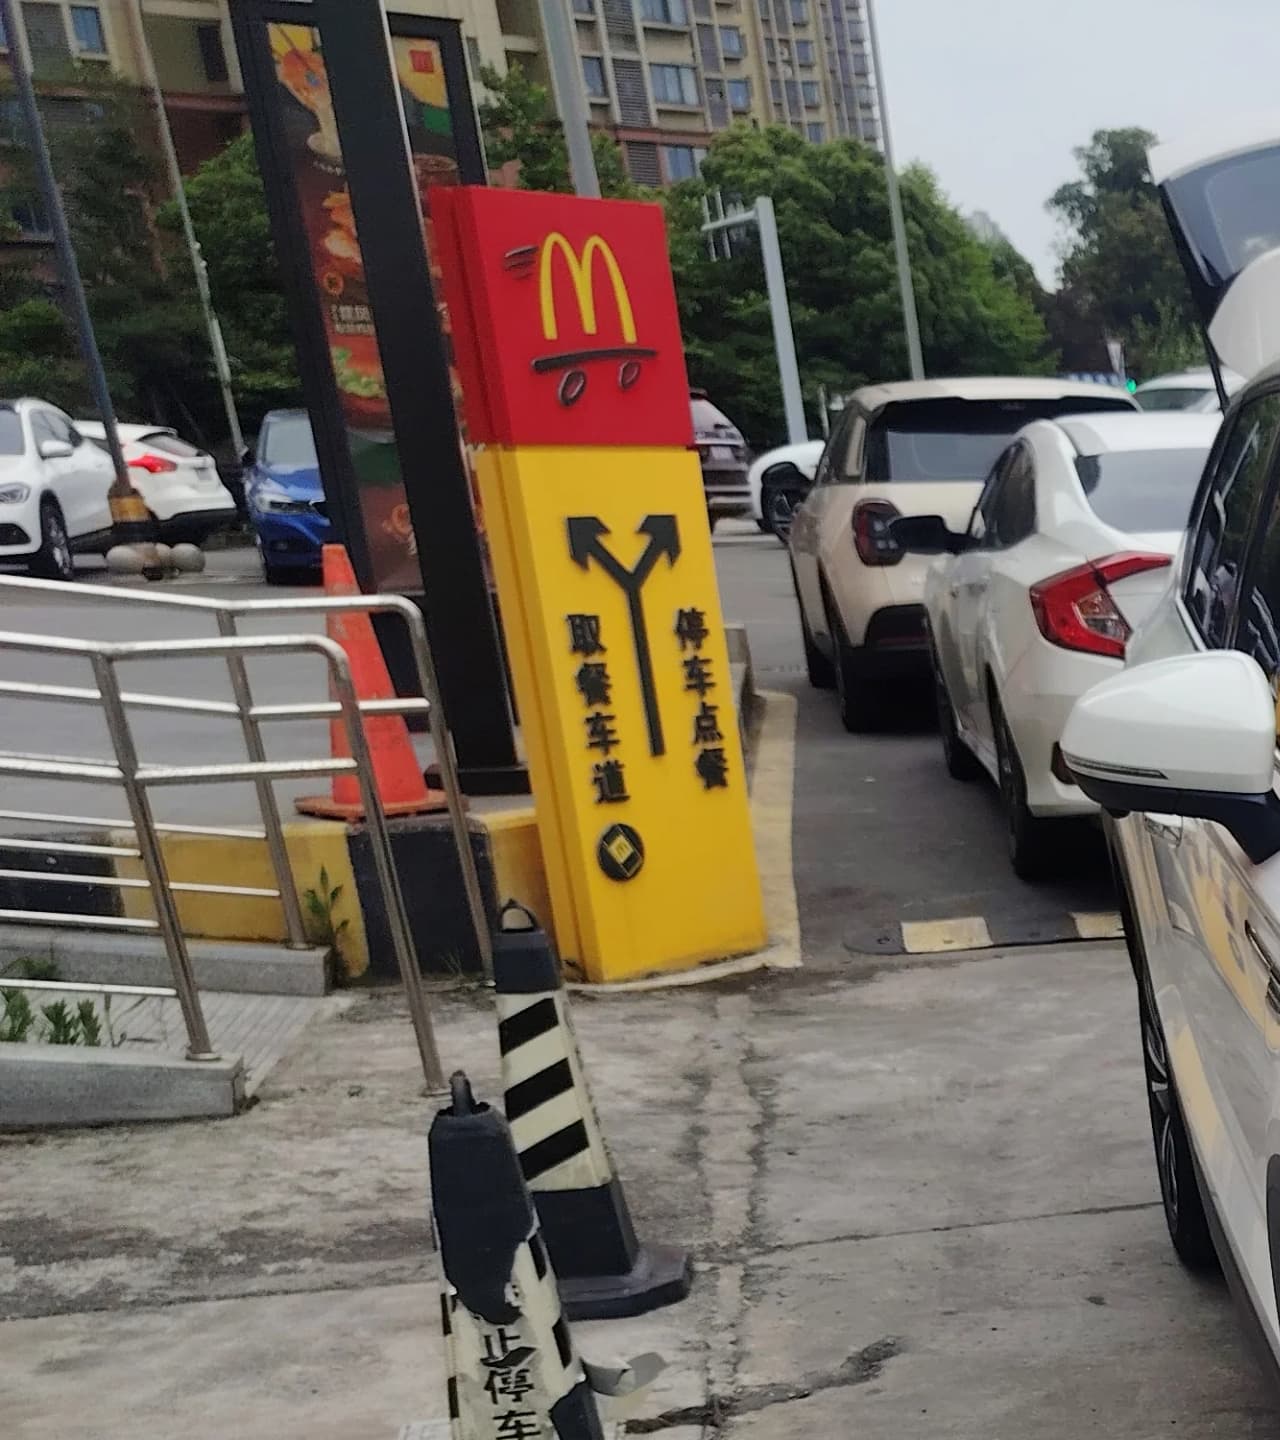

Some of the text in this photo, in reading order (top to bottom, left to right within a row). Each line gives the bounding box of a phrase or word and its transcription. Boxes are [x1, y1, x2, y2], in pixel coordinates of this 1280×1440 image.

[566, 613, 631, 804] 取餐车道
[673, 606, 730, 791] 停车点餐
